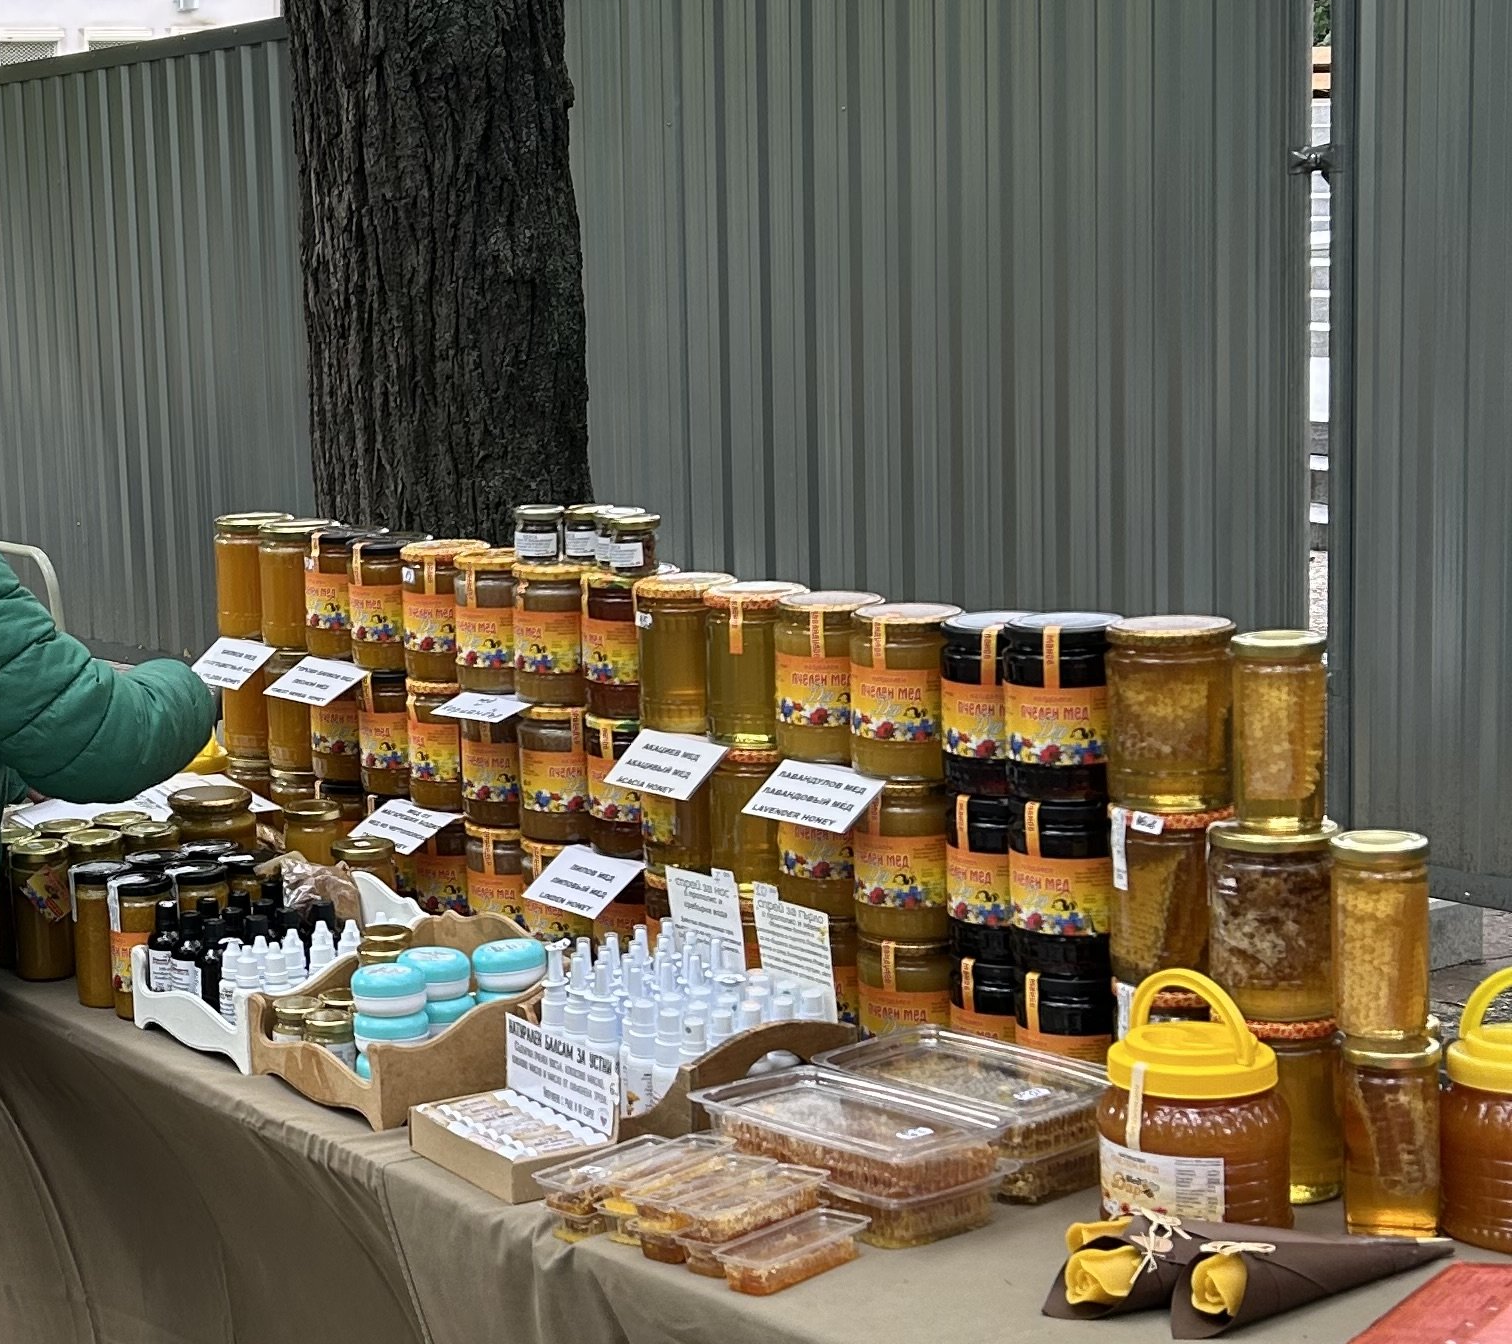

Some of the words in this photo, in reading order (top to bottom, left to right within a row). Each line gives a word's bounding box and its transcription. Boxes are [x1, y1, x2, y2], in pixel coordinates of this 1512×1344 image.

[681, 751, 701, 762] МЕД
[616, 776, 645, 788] ACACIA
[646, 783, 675, 793] HONEY
[777, 770, 843, 789] ЛАВАНДУЛОВ
[843, 783, 868, 796] МЕД
[762, 786, 832, 806] ЛАВАНДОВЫЙ
[752, 804, 801, 819] LAVENDER
[801, 814, 836, 826] HONEY
[565, 900, 594, 912] HONEY
[545, 1034, 573, 1060] БАЛСАМ
[577, 1048, 586, 1065] ЗА
[589, 1052, 612, 1075] УСТНИ
